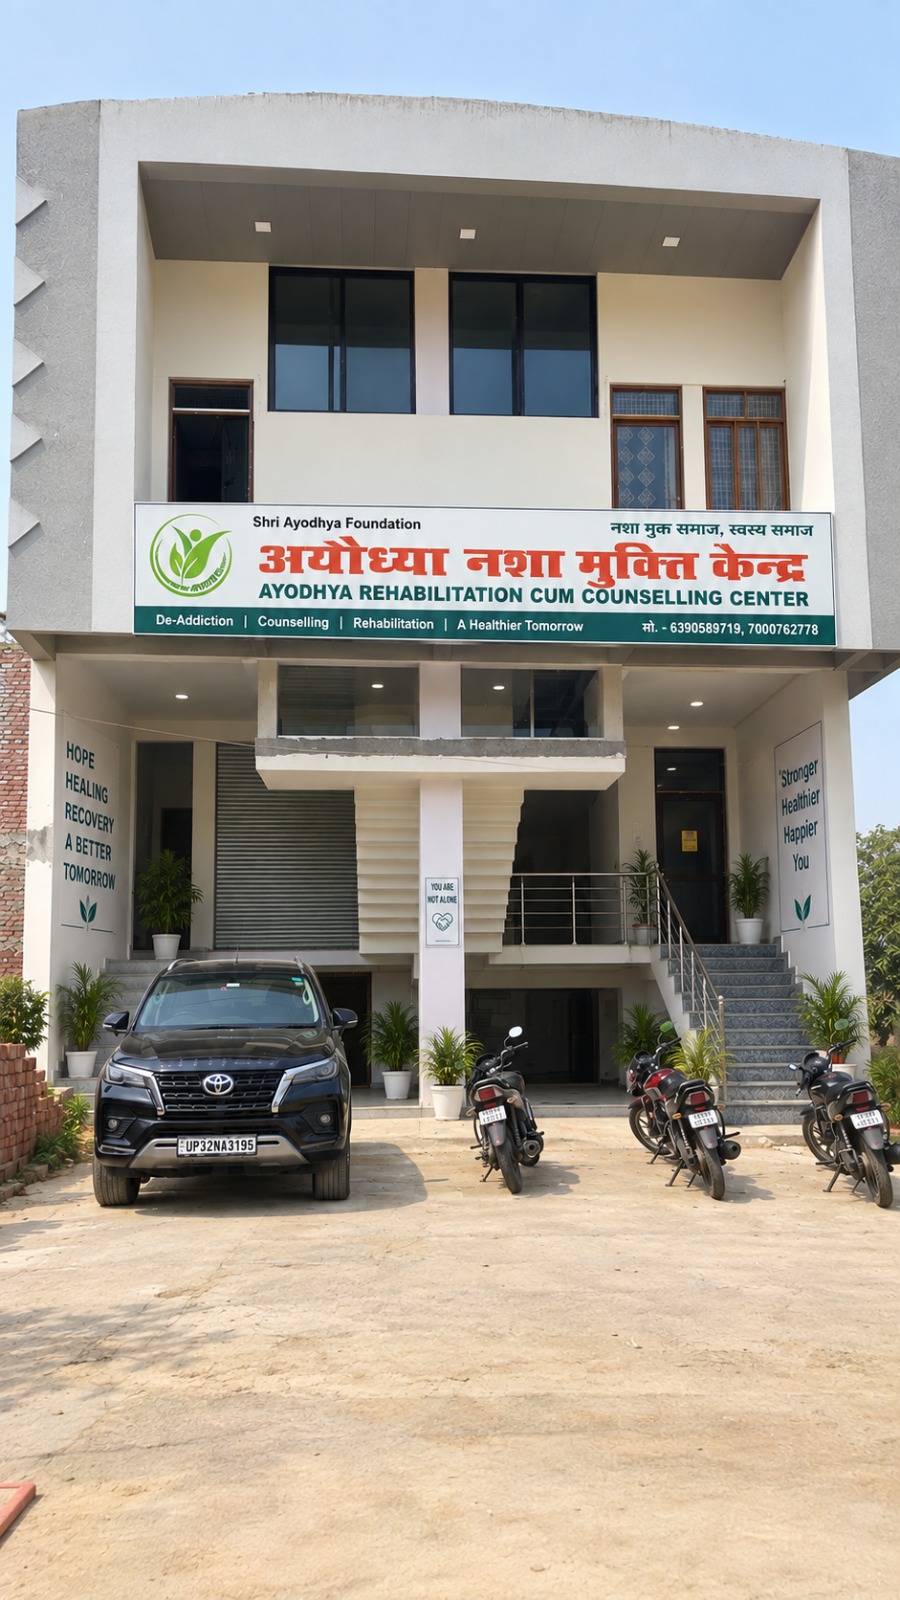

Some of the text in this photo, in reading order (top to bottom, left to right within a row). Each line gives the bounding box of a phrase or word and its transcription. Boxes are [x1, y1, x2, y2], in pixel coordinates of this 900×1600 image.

[253, 516, 421, 531] Shri Ayodhya Foundation
[610, 523, 640, 534] नशा
[676, 524, 724, 537] समाज,
[771, 525, 814, 536] समाज
[463, 549, 565, 578] नशा
[575, 542, 700, 588] मुक्ति
[258, 583, 809, 607] AYODHYA REHABILITATION CUM COUNSELLING CENTER
[156, 614, 234, 627] De-Addiction
[258, 615, 329, 630] Counselling
[353, 617, 434, 630] Rehabilitation
[457, 619, 584, 632] A Healthier Tomorrow
[670, 622, 745, 636] 6390589719,
[748, 623, 819, 635] 7000762778
[66, 741, 95, 769] HOPE
[65, 771, 109, 804] HEALING
[782, 788, 820, 816] Healthier
[65, 802, 115, 834] RECOVERY
[784, 819, 818, 845] Happier
[65, 833, 112, 861] A BETTER
[793, 853, 810, 871] You
[63, 862, 116, 890] TOMORROW
[431, 883, 442, 891] YOU
[186, 1140, 254, 1152] UP32NA3195
